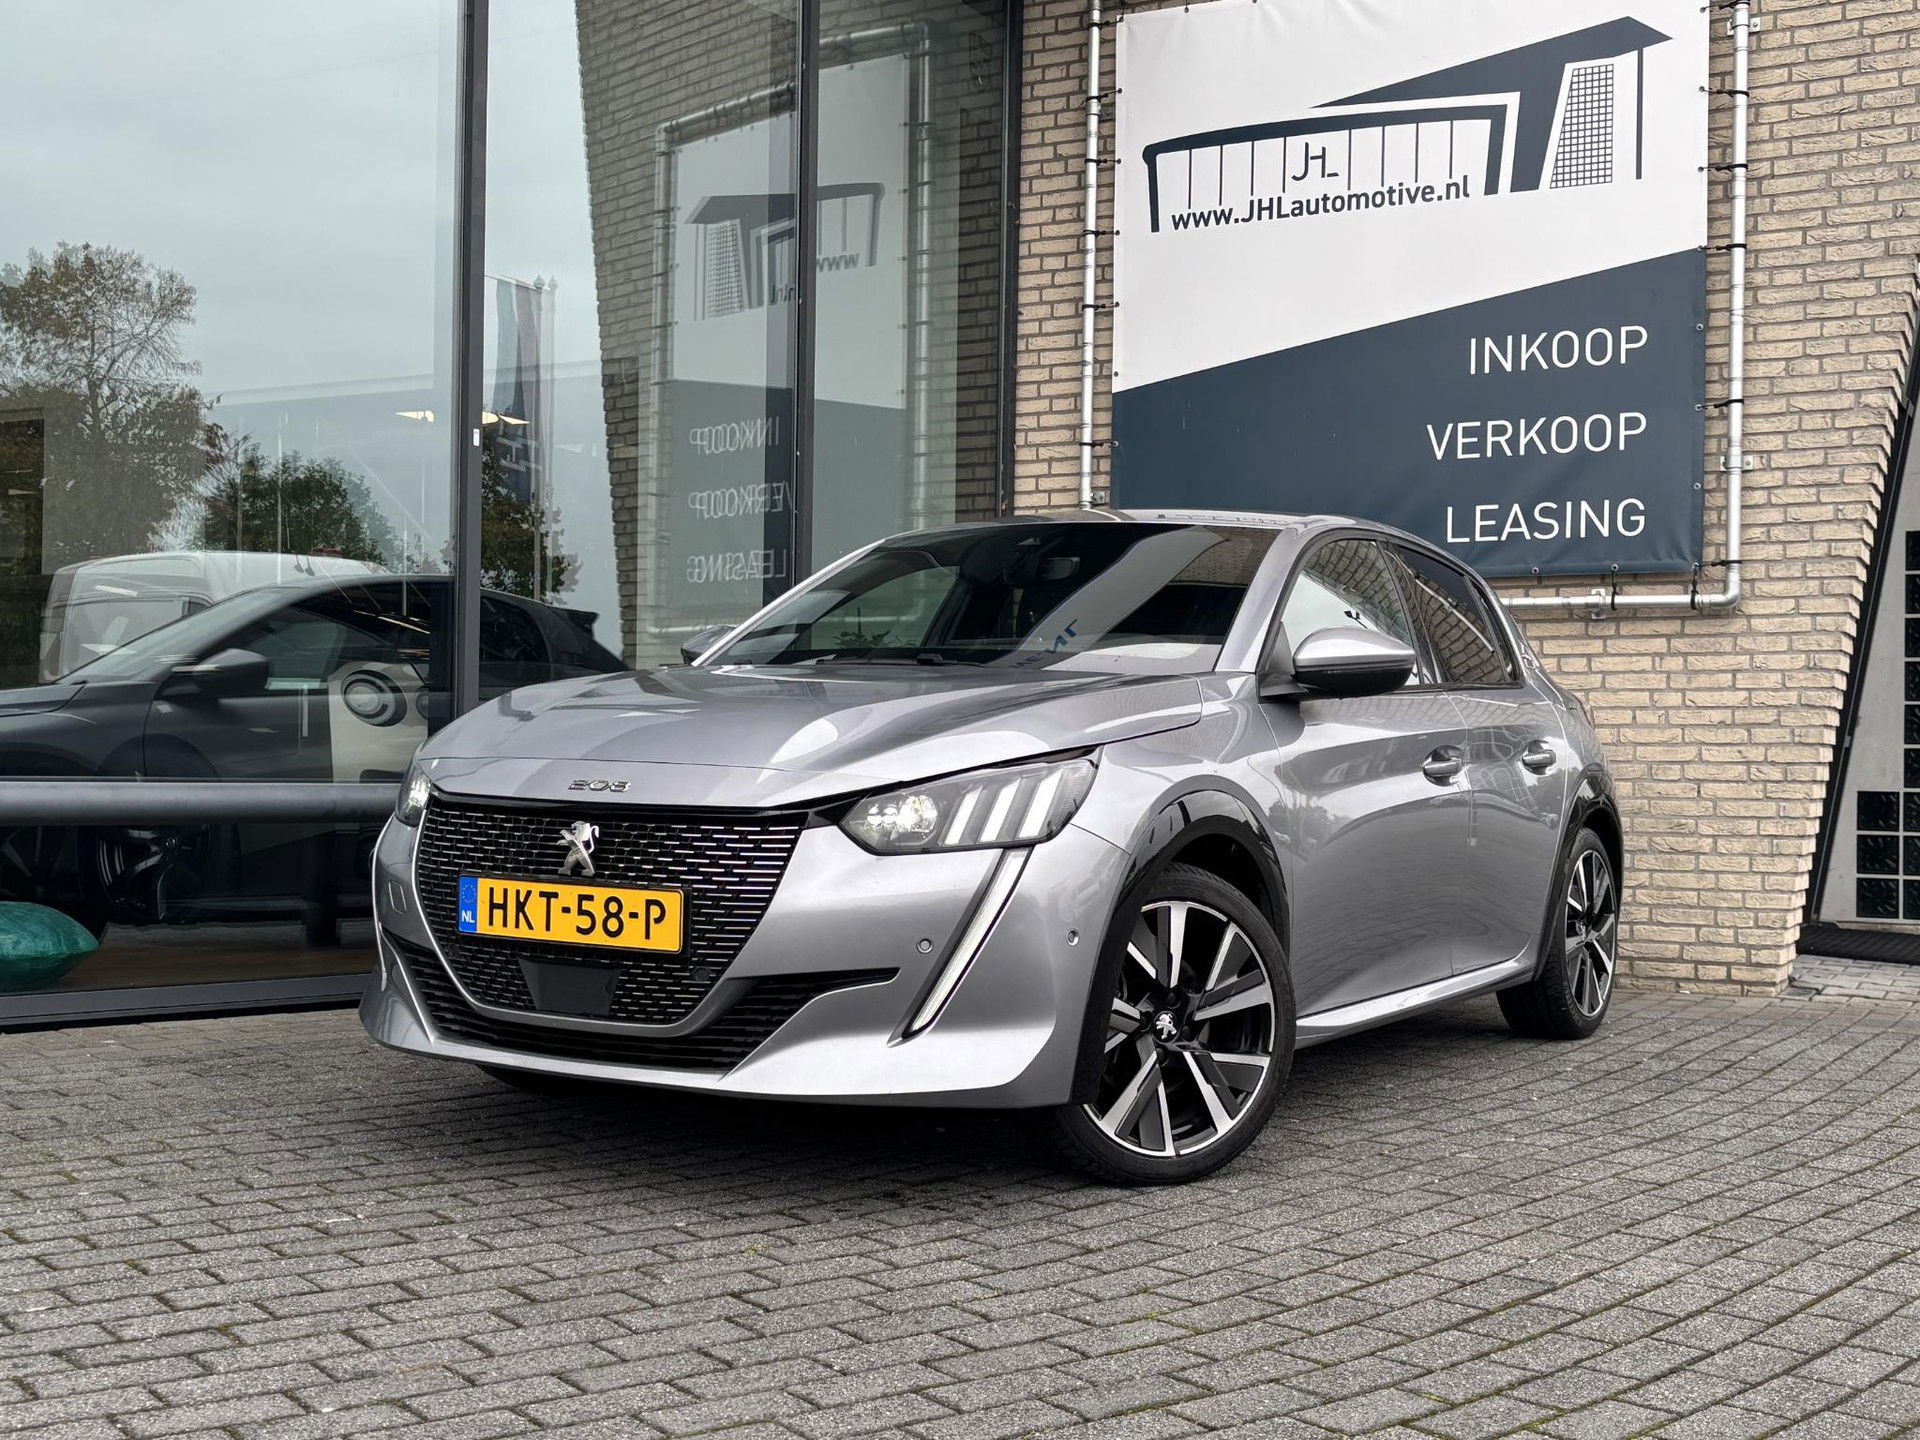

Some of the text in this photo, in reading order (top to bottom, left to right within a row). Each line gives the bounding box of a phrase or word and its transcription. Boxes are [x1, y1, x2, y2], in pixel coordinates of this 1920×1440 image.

[1291, 141, 1340, 181] JHL
[1171, 174, 1470, 231] www.JHLautomotive.nl
[1470, 325, 1648, 375] INKOOP
[1426, 411, 1647, 461] VERKOOP
[1446, 498, 1646, 543] LEASING
[568, 779, 631, 793] 208
[461, 910, 475, 923] NL
[488, 886, 667, 940] HKT-58-P
